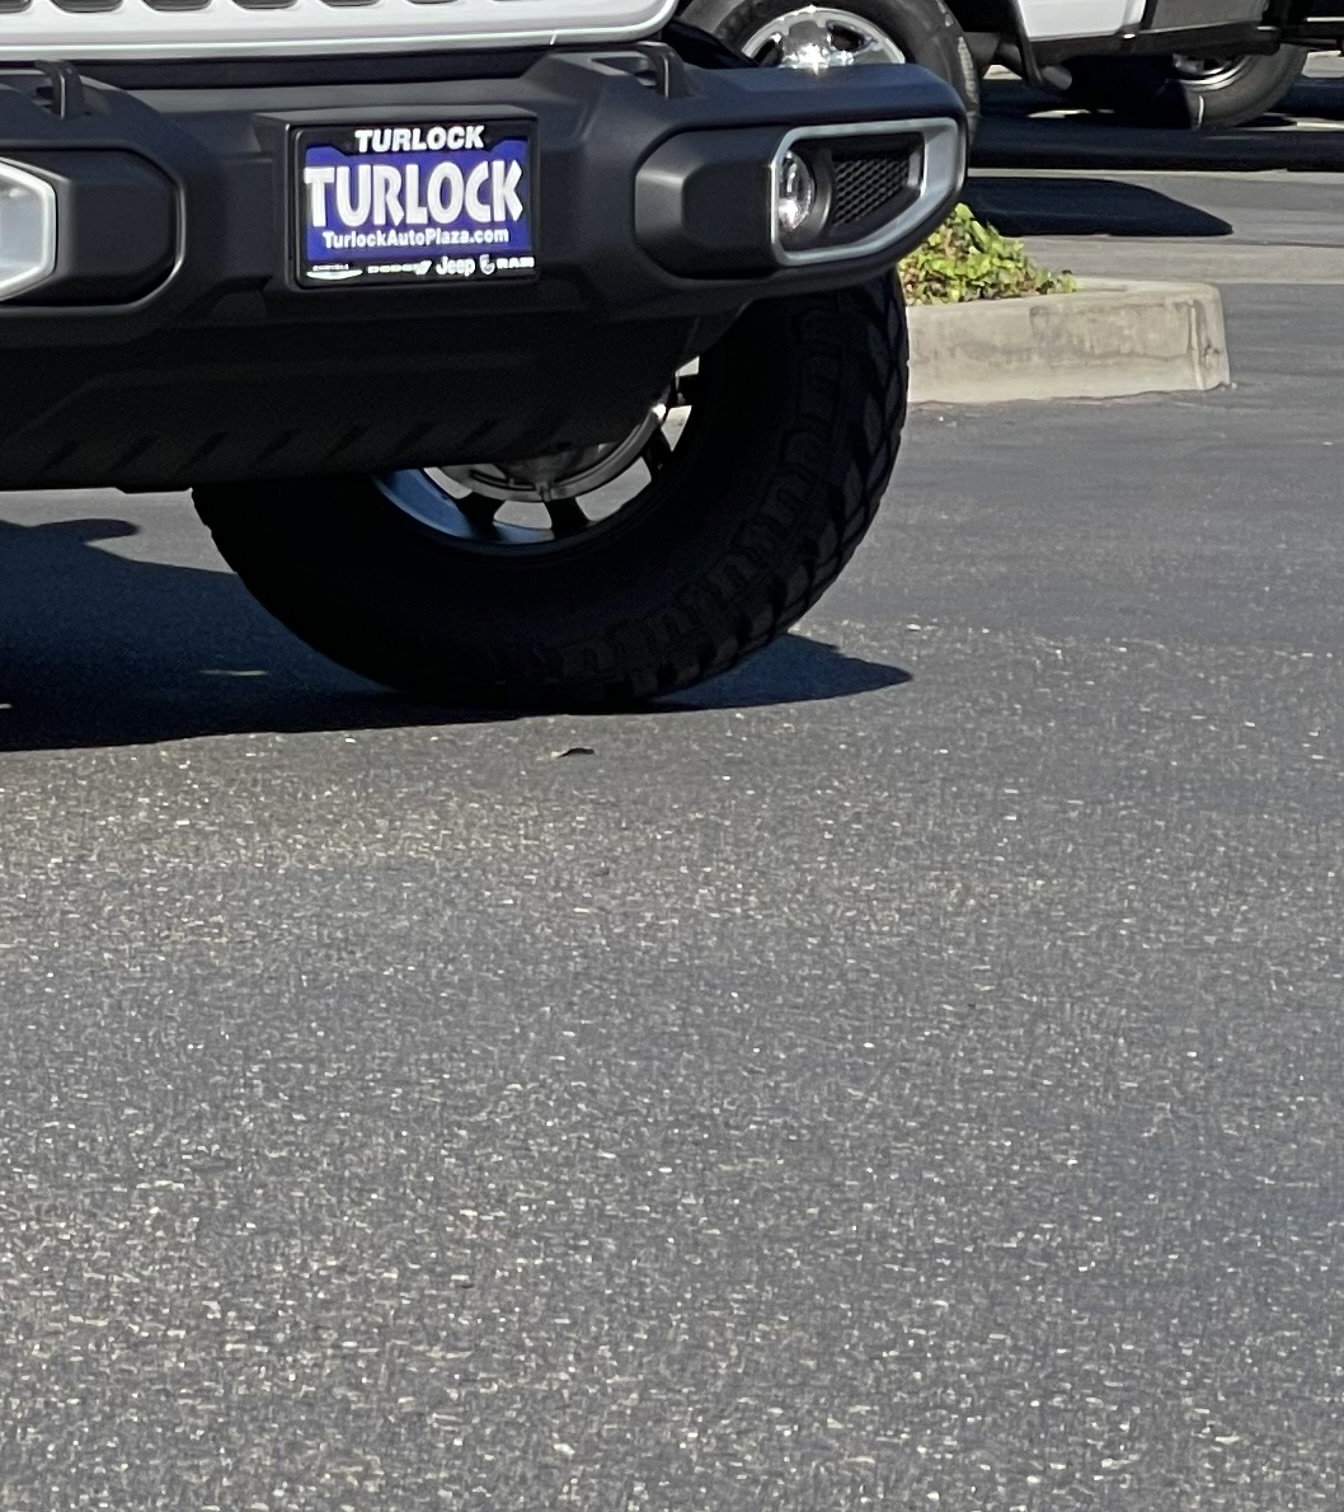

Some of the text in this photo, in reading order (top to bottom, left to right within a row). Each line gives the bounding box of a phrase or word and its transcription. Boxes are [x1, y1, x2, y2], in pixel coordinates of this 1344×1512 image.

[354, 125, 486, 153] TURLOCK
[303, 159, 524, 227] TURLOCK
[322, 227, 510, 249] TurlockAutoPlaza.com
[436, 255, 476, 277] Jeep
